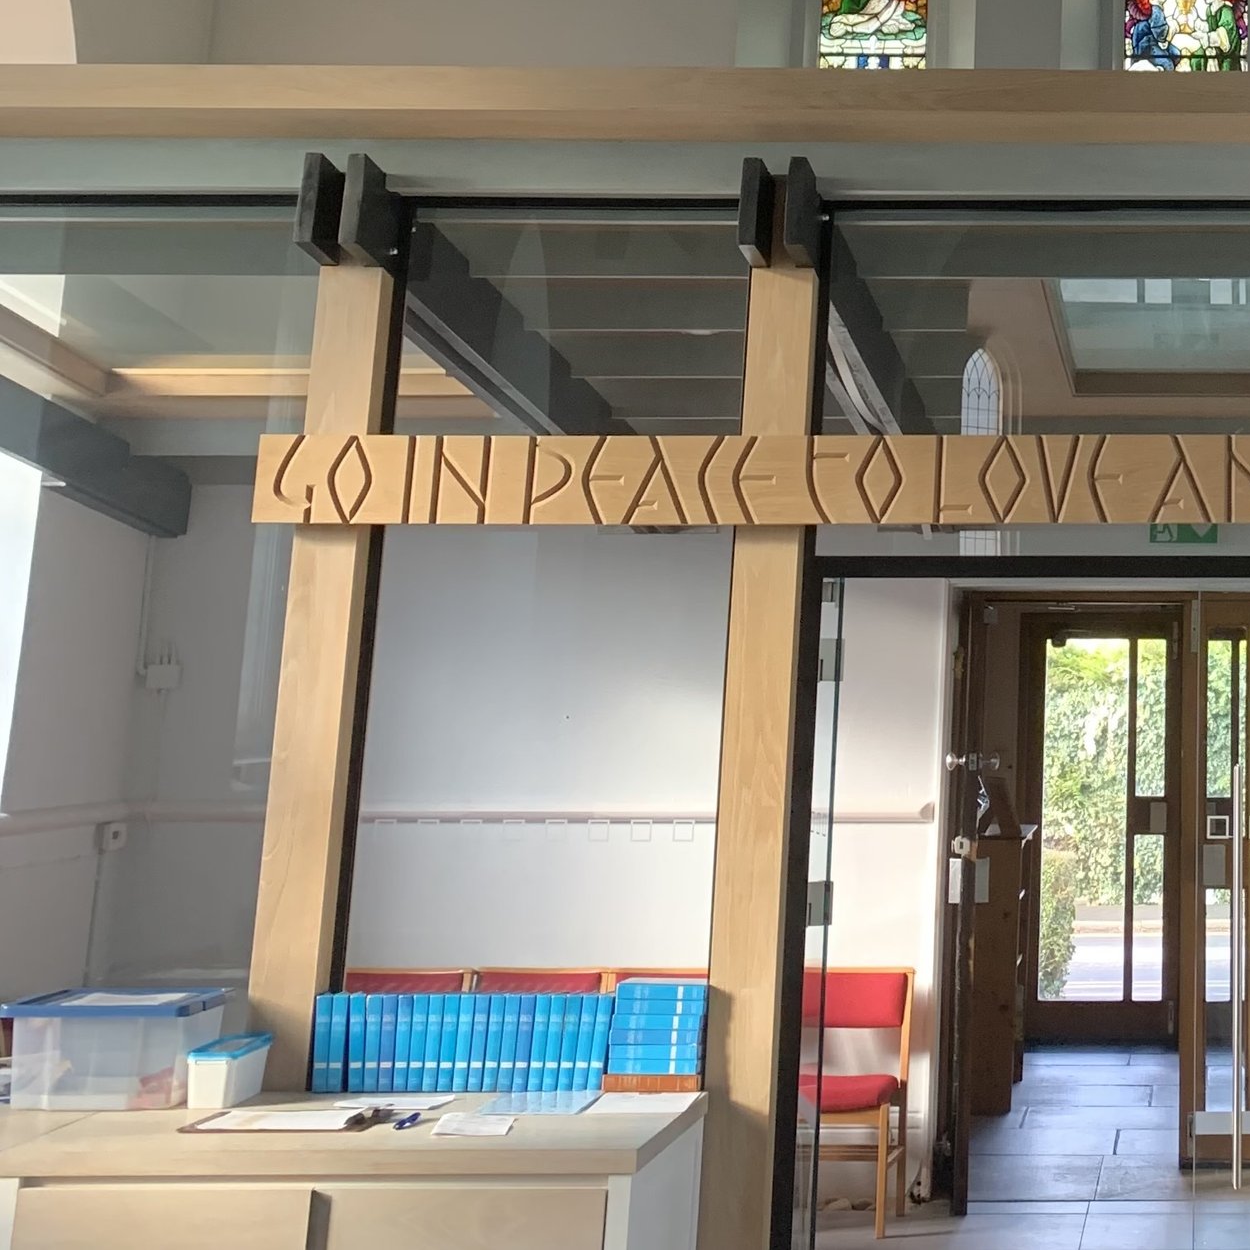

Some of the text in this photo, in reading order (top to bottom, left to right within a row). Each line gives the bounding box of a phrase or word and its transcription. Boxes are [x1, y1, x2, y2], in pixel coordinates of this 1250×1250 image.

[273, 435, 373, 524] GO
[402, 435, 493, 524] IN
[523, 435, 776, 524] PEACE
[806, 435, 905, 524] TO
[933, 435, 1124, 524] LOVE
